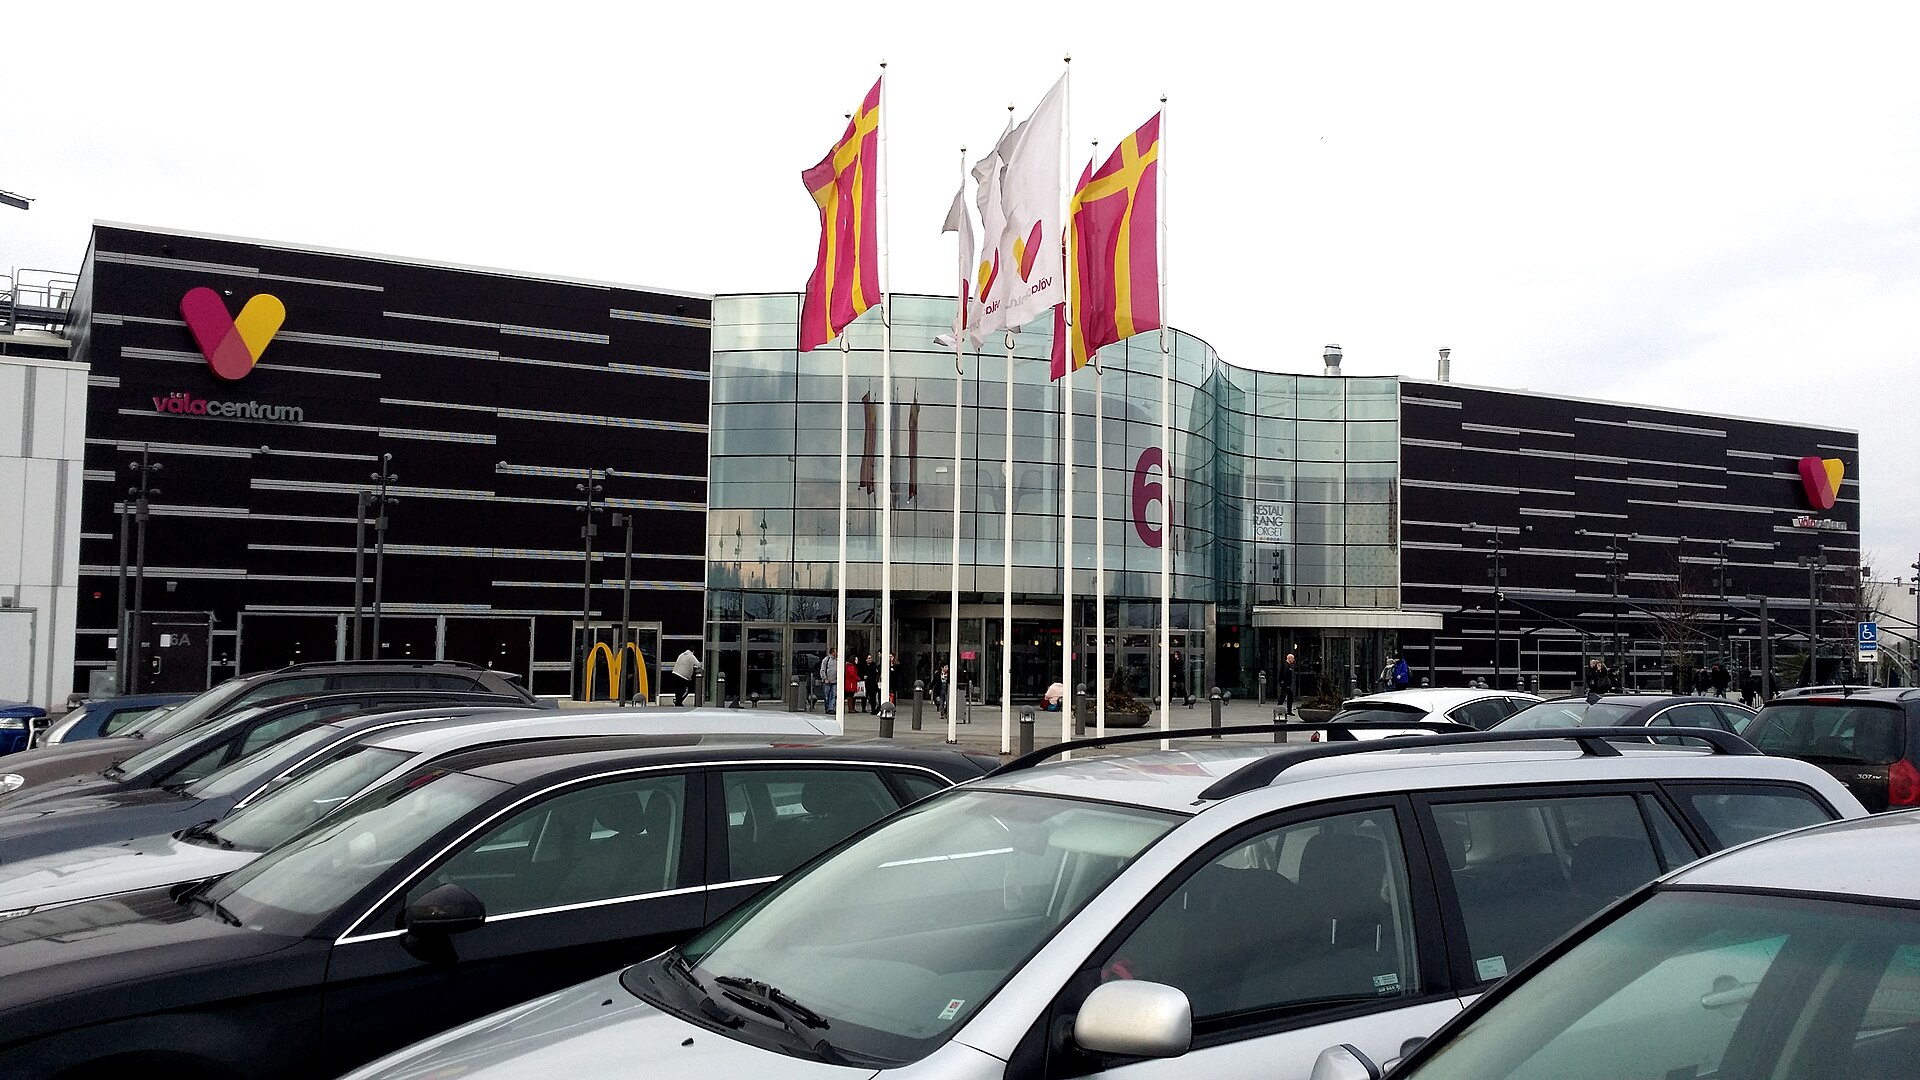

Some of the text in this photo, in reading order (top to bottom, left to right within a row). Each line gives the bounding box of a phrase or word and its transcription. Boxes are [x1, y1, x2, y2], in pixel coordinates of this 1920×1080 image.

[1132, 446, 1174, 549] 6
[1256, 526, 1282, 537] ORGET
[170, 633, 191, 646] 6A
